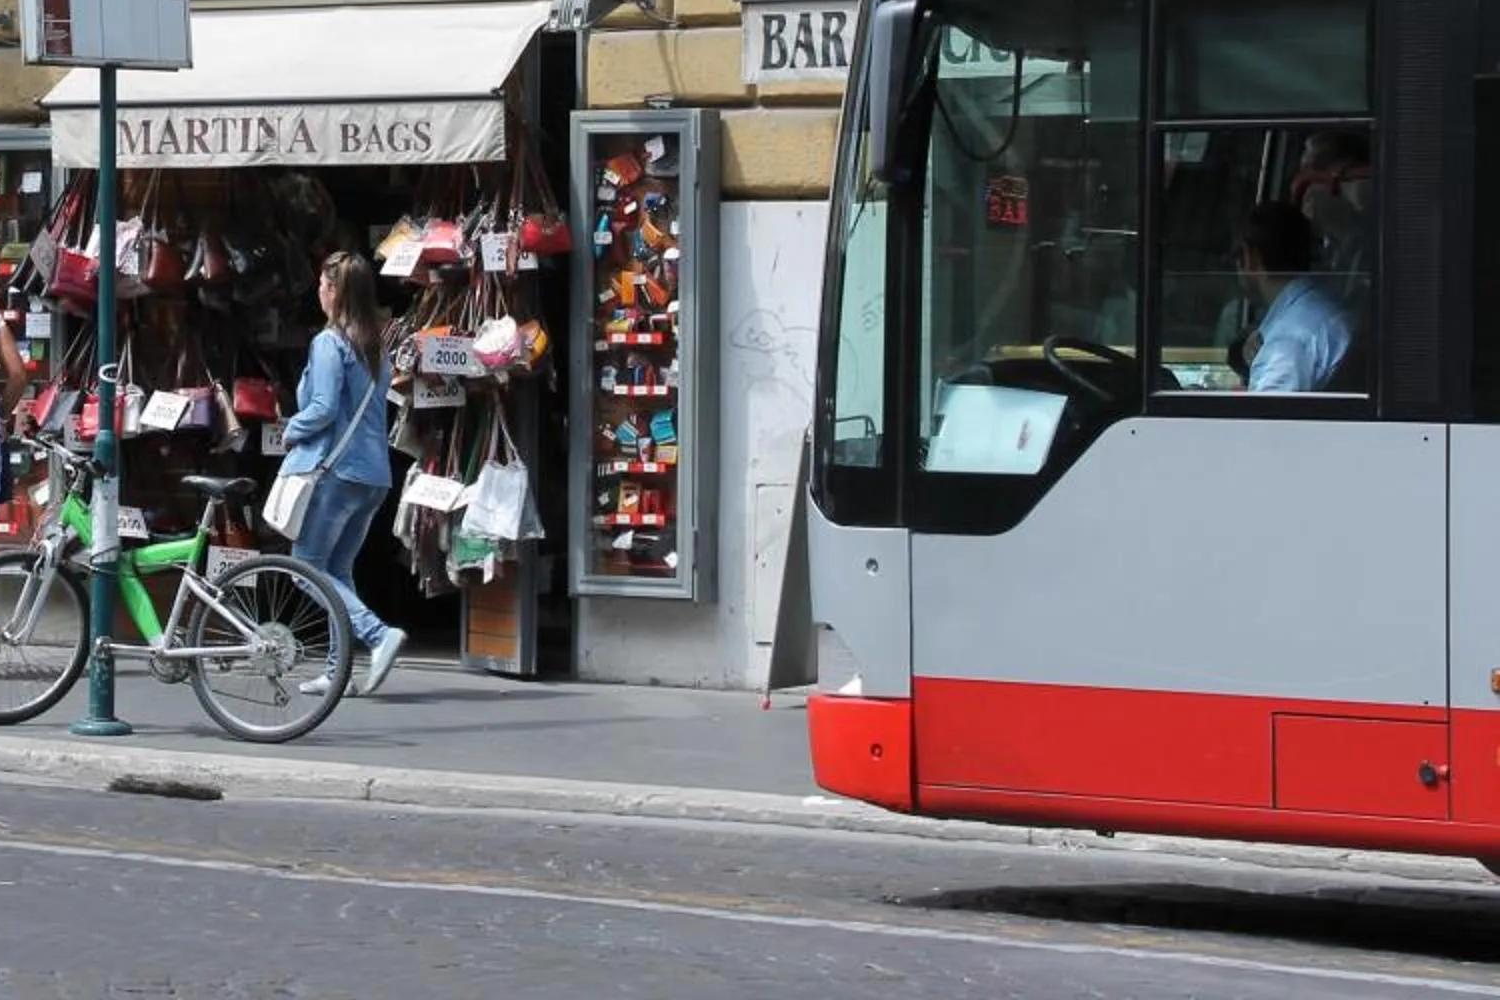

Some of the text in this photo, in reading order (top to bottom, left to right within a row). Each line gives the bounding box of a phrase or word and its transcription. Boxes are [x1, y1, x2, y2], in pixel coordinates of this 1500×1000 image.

[761, 11, 849, 70] BAR
[118, 116, 432, 156] MARTINA BAGS
